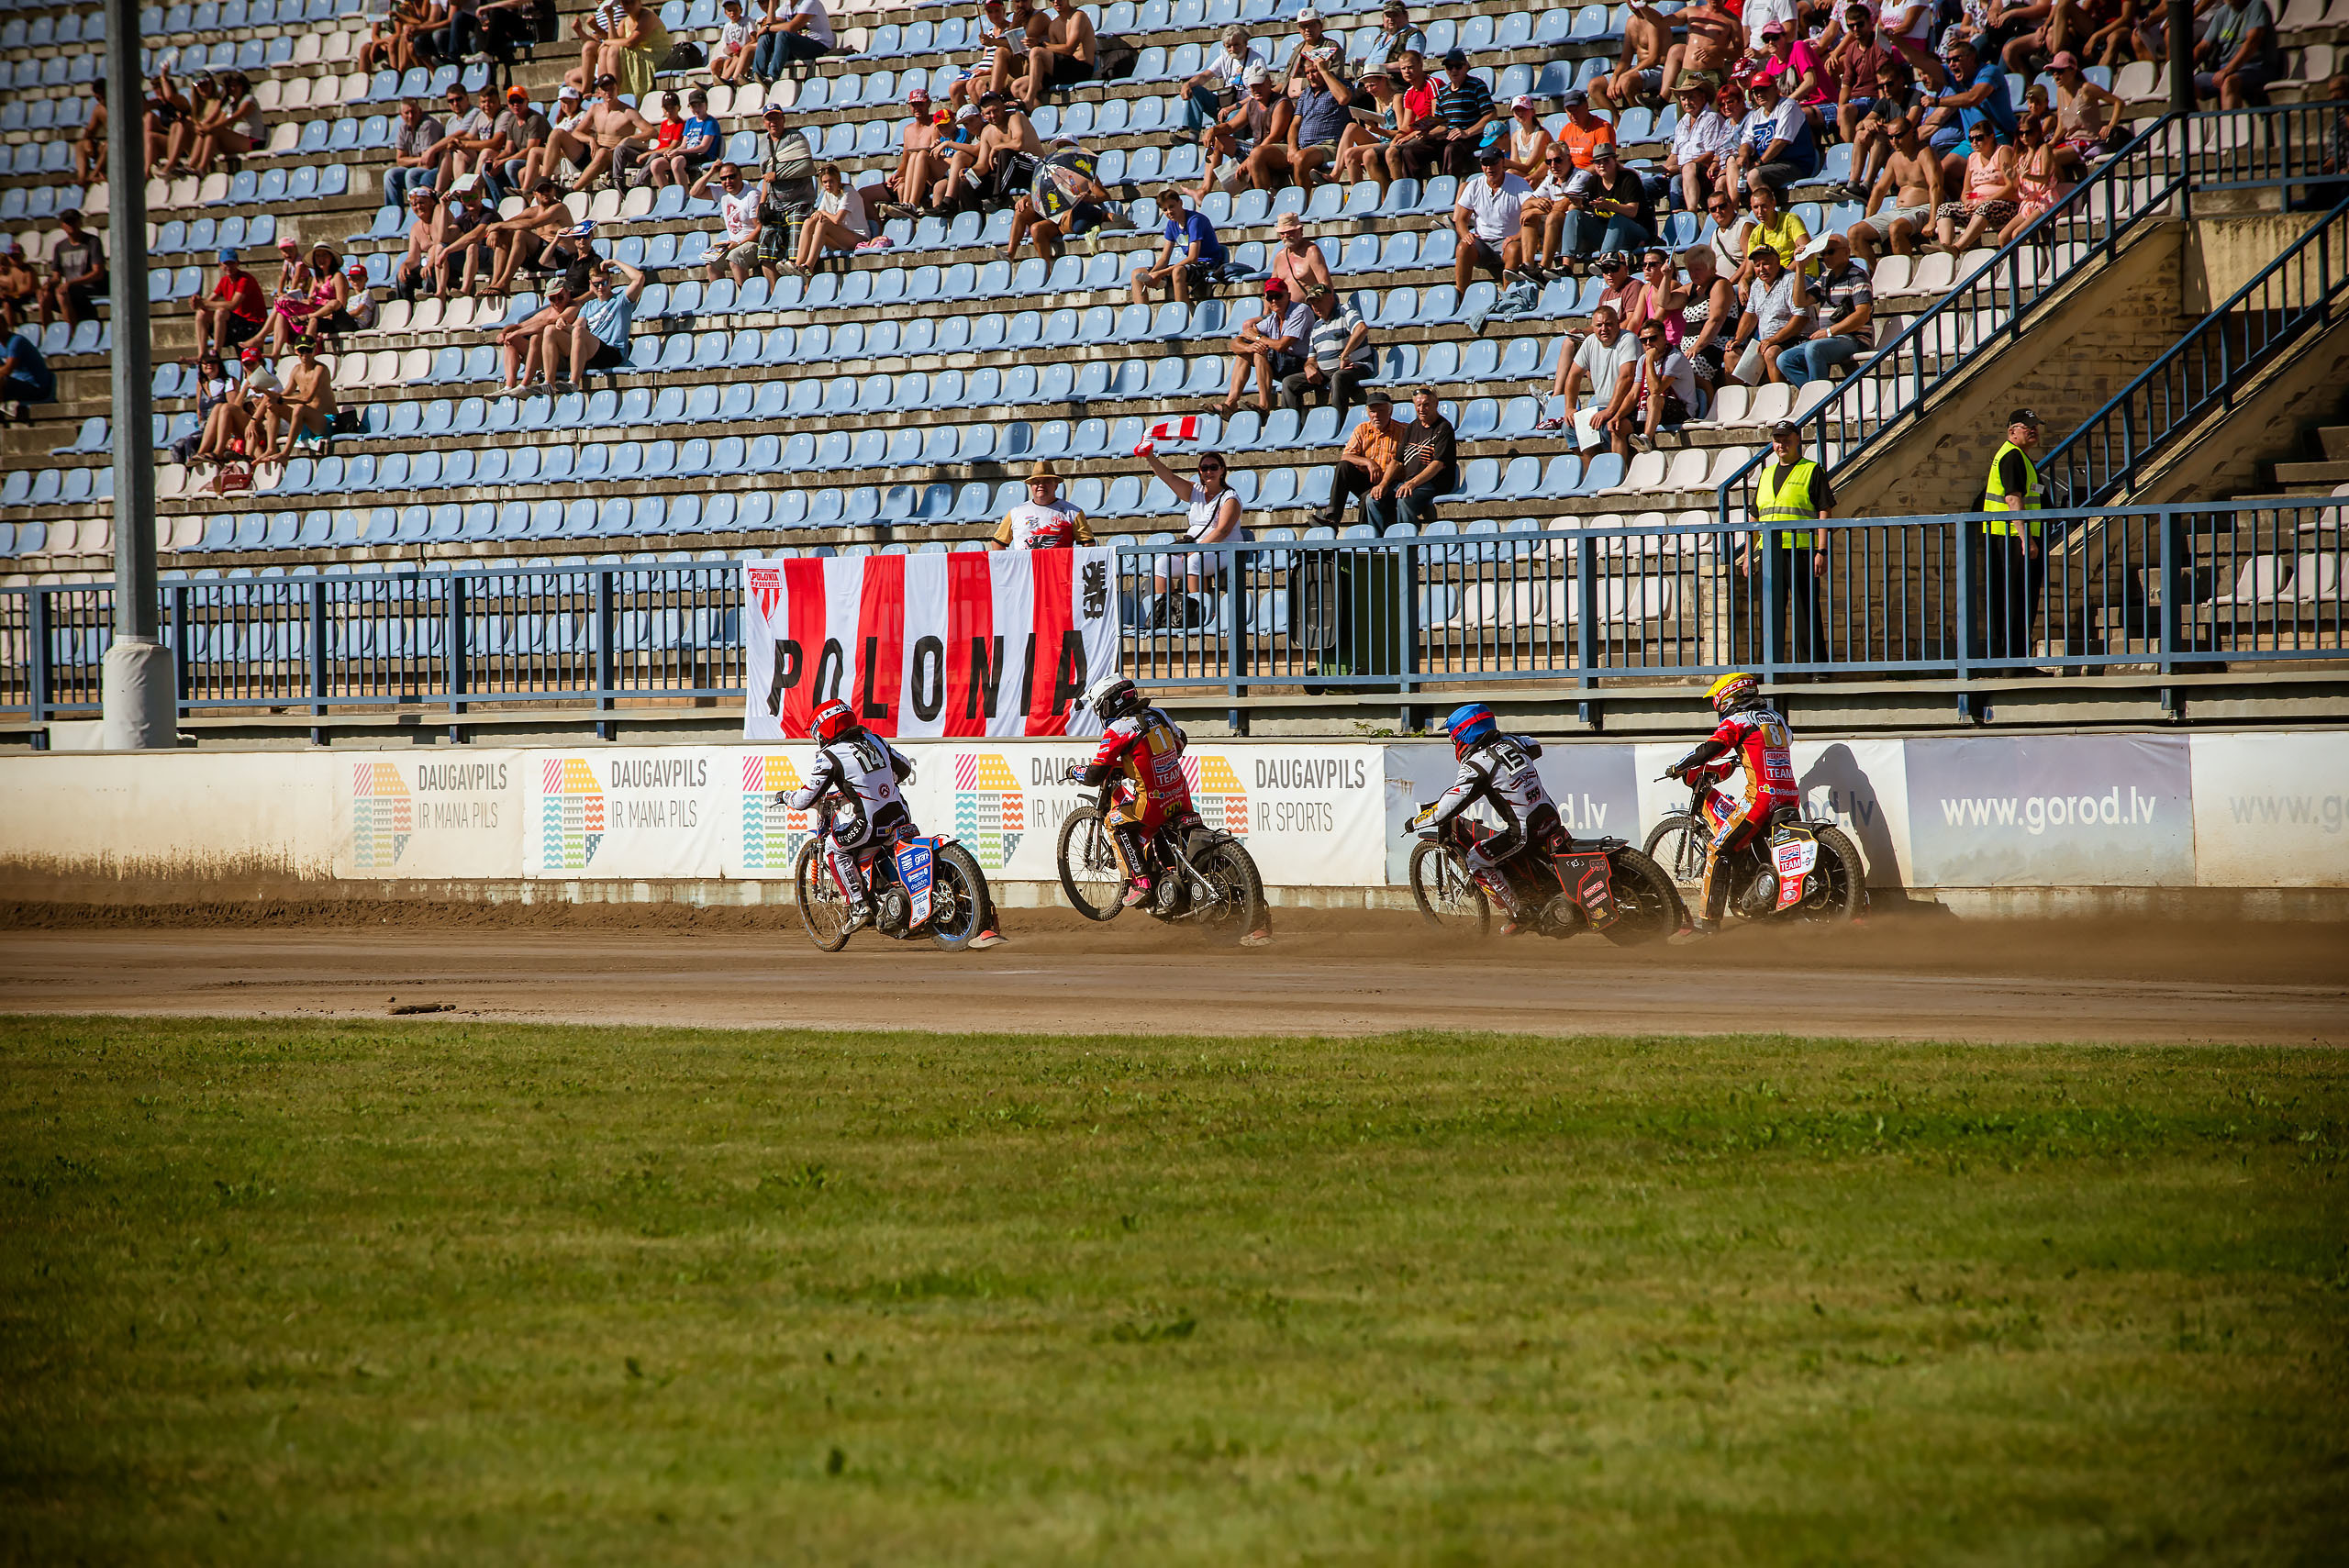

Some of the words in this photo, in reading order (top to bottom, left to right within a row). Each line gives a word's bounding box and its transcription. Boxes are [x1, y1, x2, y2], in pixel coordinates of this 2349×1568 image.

[1207, 360, 1215, 368] 20
[1441, 404, 1447, 414] 12
[1050, 425, 1060, 433] 22
[765, 629, 1088, 722] POLONIA
[1155, 728, 1168, 750] 1
[1768, 724, 1782, 746] 8
[612, 759, 707, 788] DAUGAVPILS
[853, 747, 886, 773] 14
[1499, 749, 1529, 776] 15
[419, 763, 507, 791] DAUGAVPILS
[1255, 759, 1365, 789] DAUGAVPILS
[418, 802, 429, 828] IR
[435, 801, 469, 828] MANA
[473, 801, 498, 828] PILS
[612, 801, 624, 828] IR
[629, 800, 666, 828] MANA
[670, 799, 697, 828] PILS
[1032, 800, 1046, 828] IR
[1256, 802, 1271, 830] IR
[1276, 802, 1333, 832] SPORTS
[1941, 785, 2156, 835] www.gorod.lv
[1781, 859, 1801, 873] TEAM
